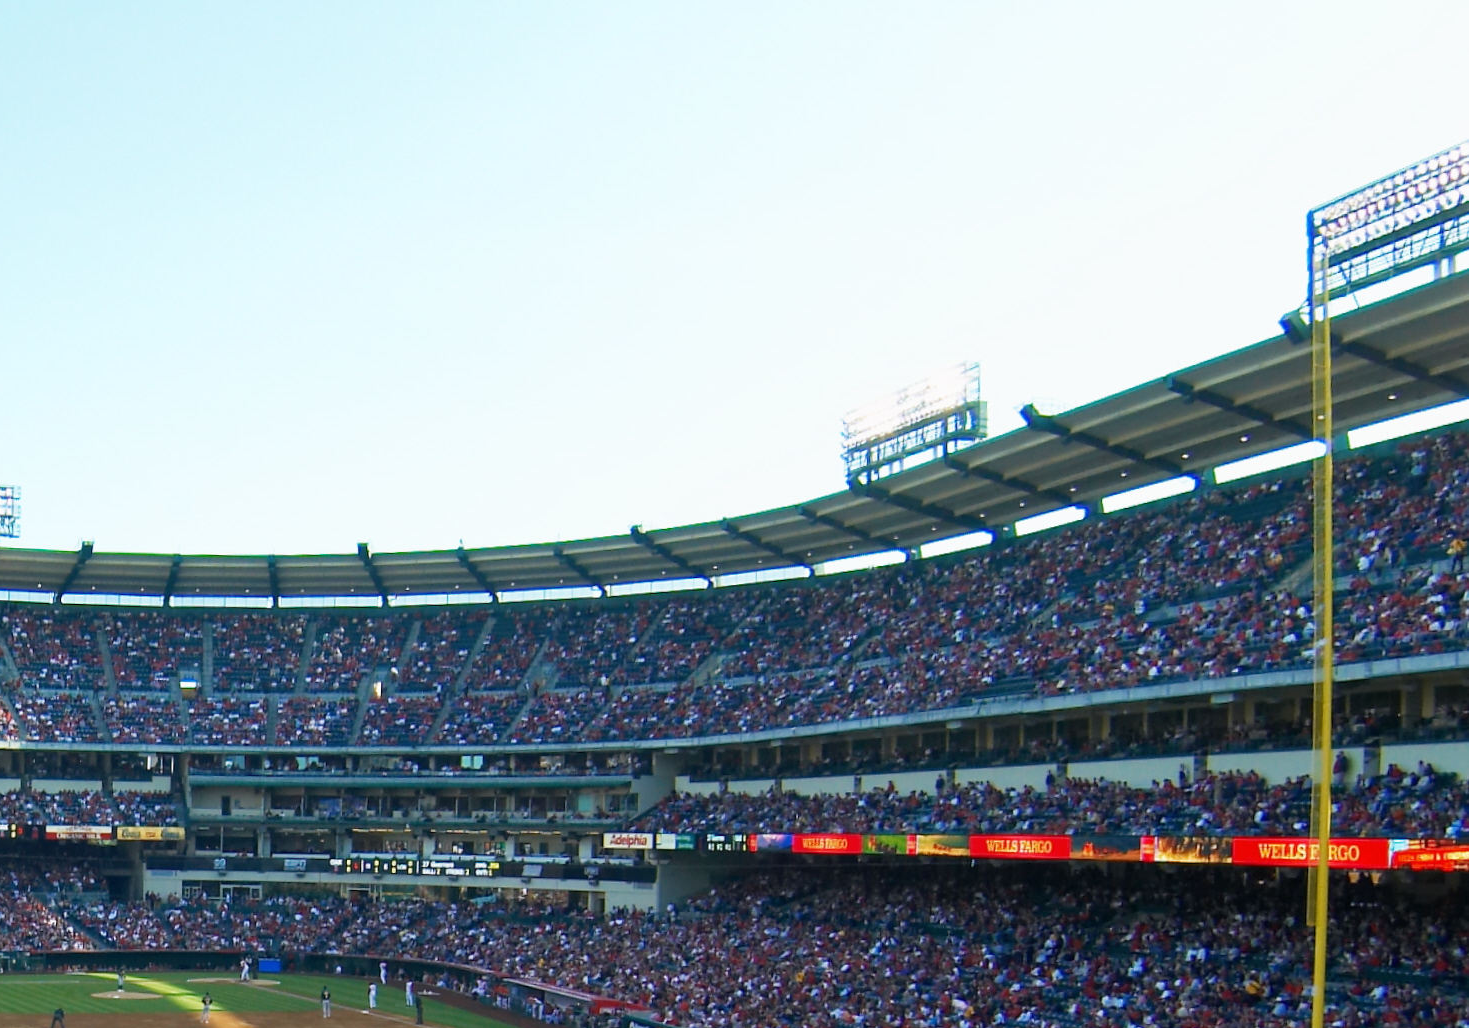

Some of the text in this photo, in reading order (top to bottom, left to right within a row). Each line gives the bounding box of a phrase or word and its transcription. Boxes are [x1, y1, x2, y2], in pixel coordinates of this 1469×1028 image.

[610, 834, 647, 847] Adelphia
[986, 839, 1053, 853] WELLS FARGO
[1258, 843, 1360, 862] WELLS FRGO
